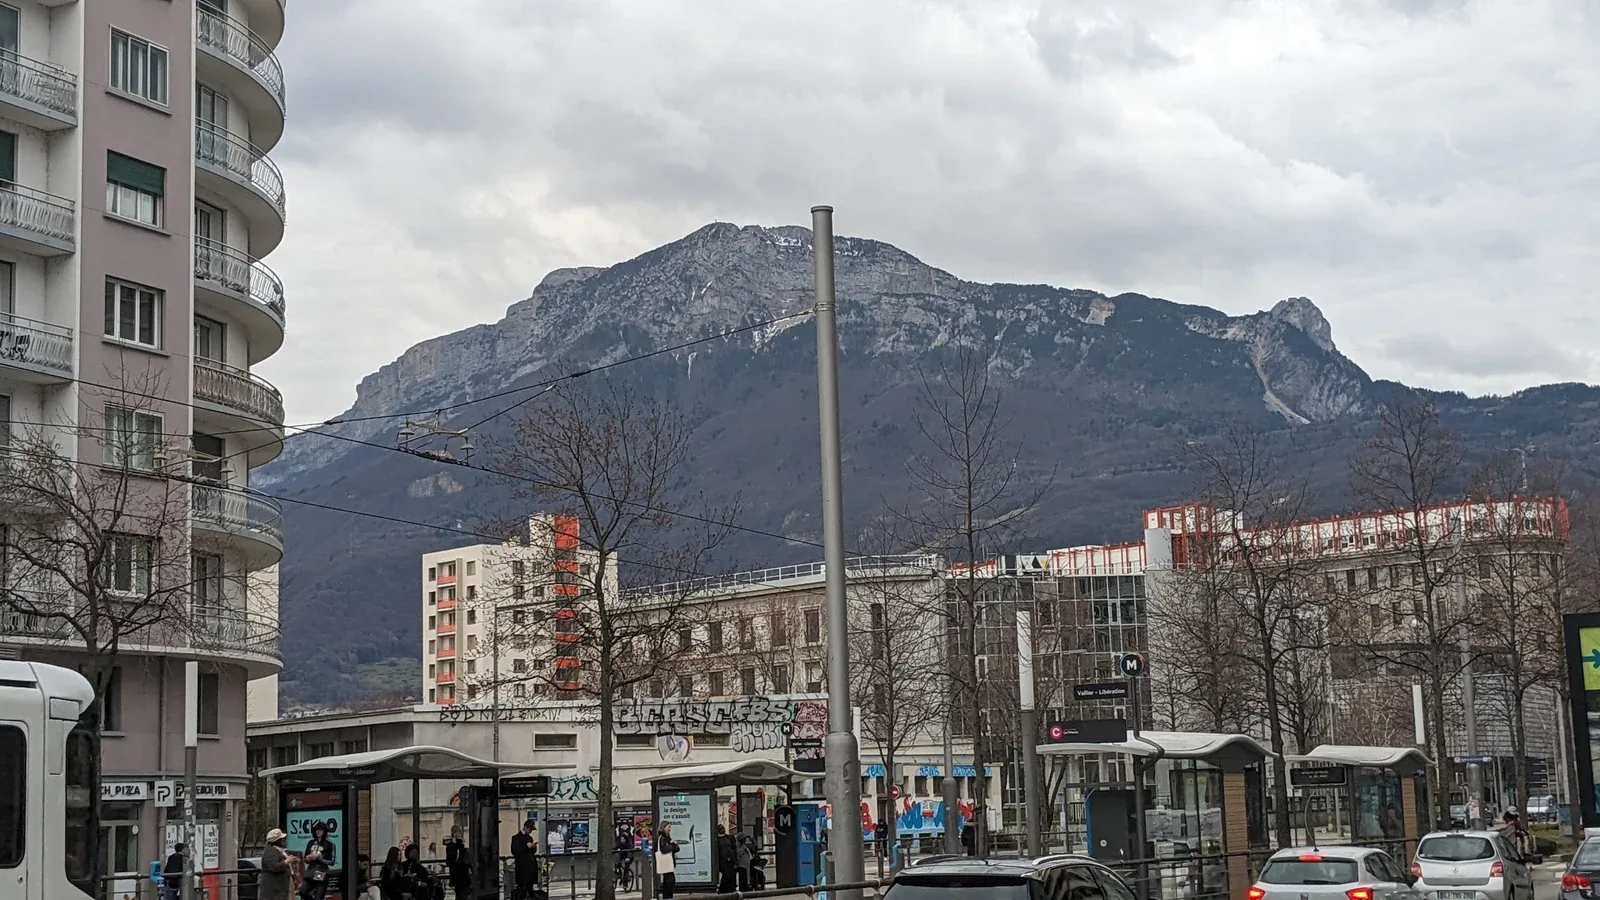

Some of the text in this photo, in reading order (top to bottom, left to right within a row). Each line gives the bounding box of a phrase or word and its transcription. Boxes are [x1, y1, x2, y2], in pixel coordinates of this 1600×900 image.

[1126, 660, 1137, 670] M
[1052, 727, 1060, 737] C
[115, 785, 141, 795] PIZZA
[780, 813, 791, 827] M
